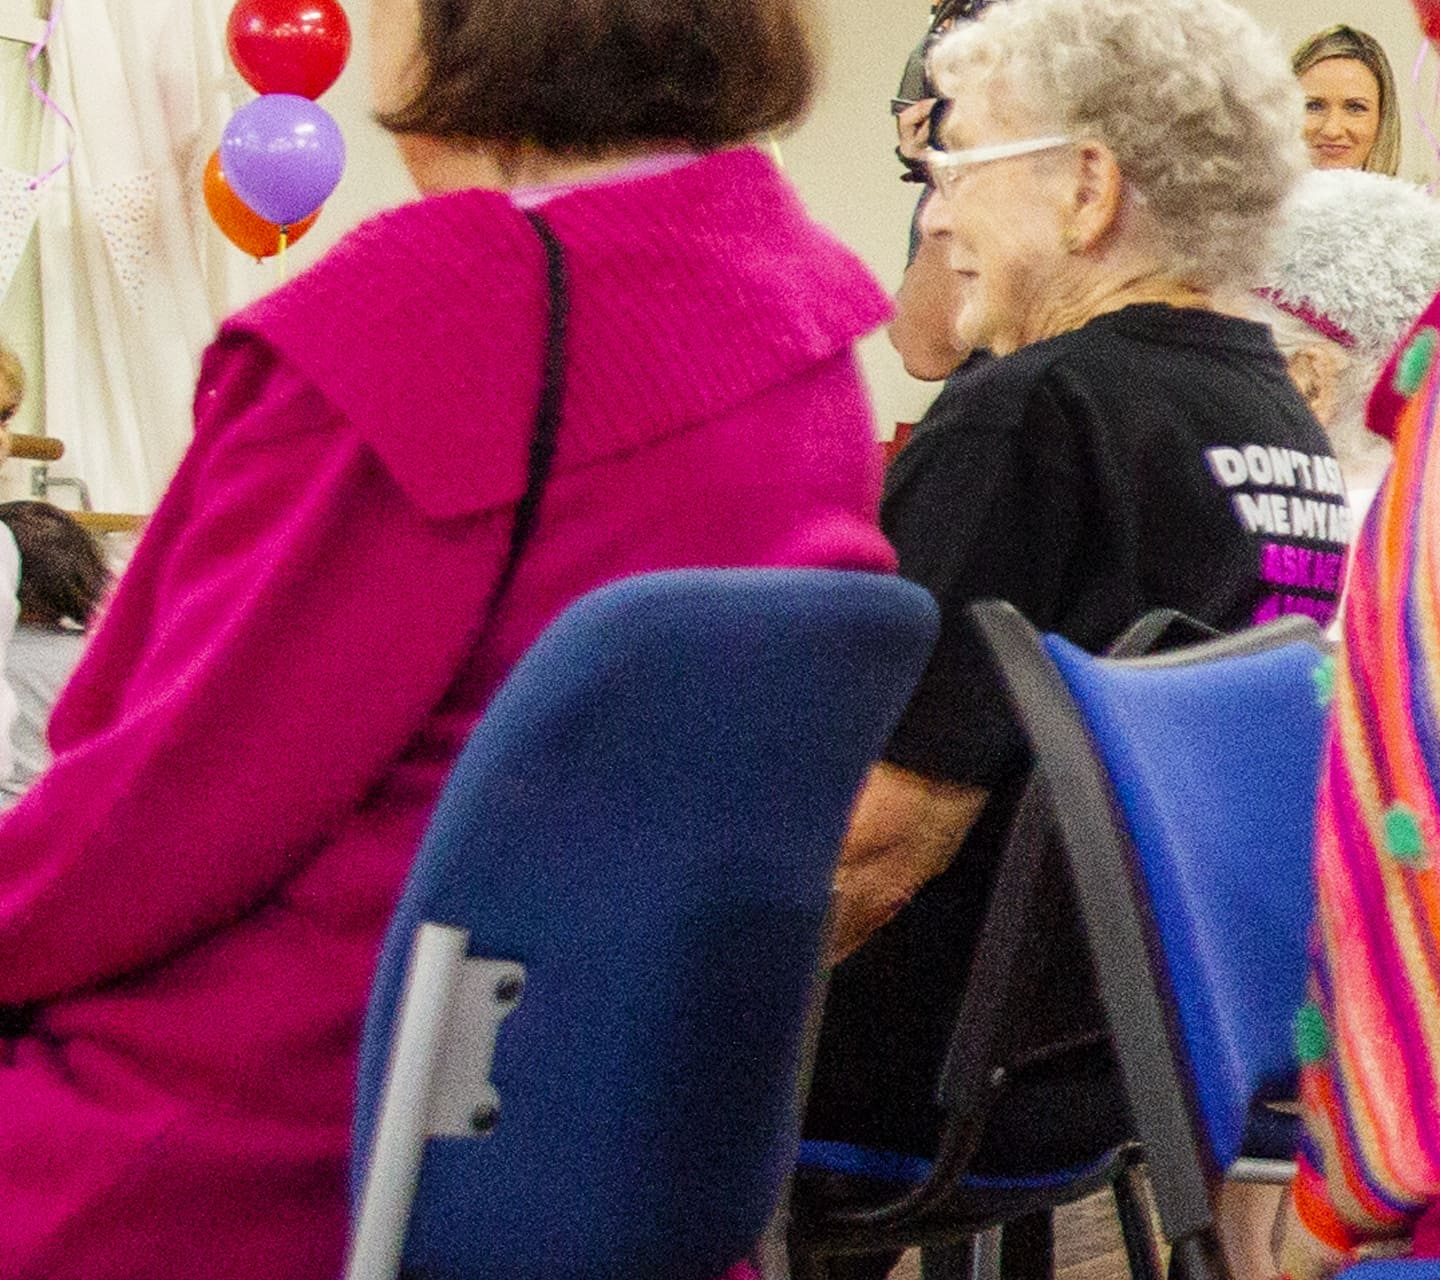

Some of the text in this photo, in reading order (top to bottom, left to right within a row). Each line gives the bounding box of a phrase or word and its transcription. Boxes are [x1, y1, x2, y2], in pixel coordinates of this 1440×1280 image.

[1207, 444, 1345, 497] DON'T AS
[1236, 493, 1292, 535] ME
[1292, 498, 1328, 540] MY
